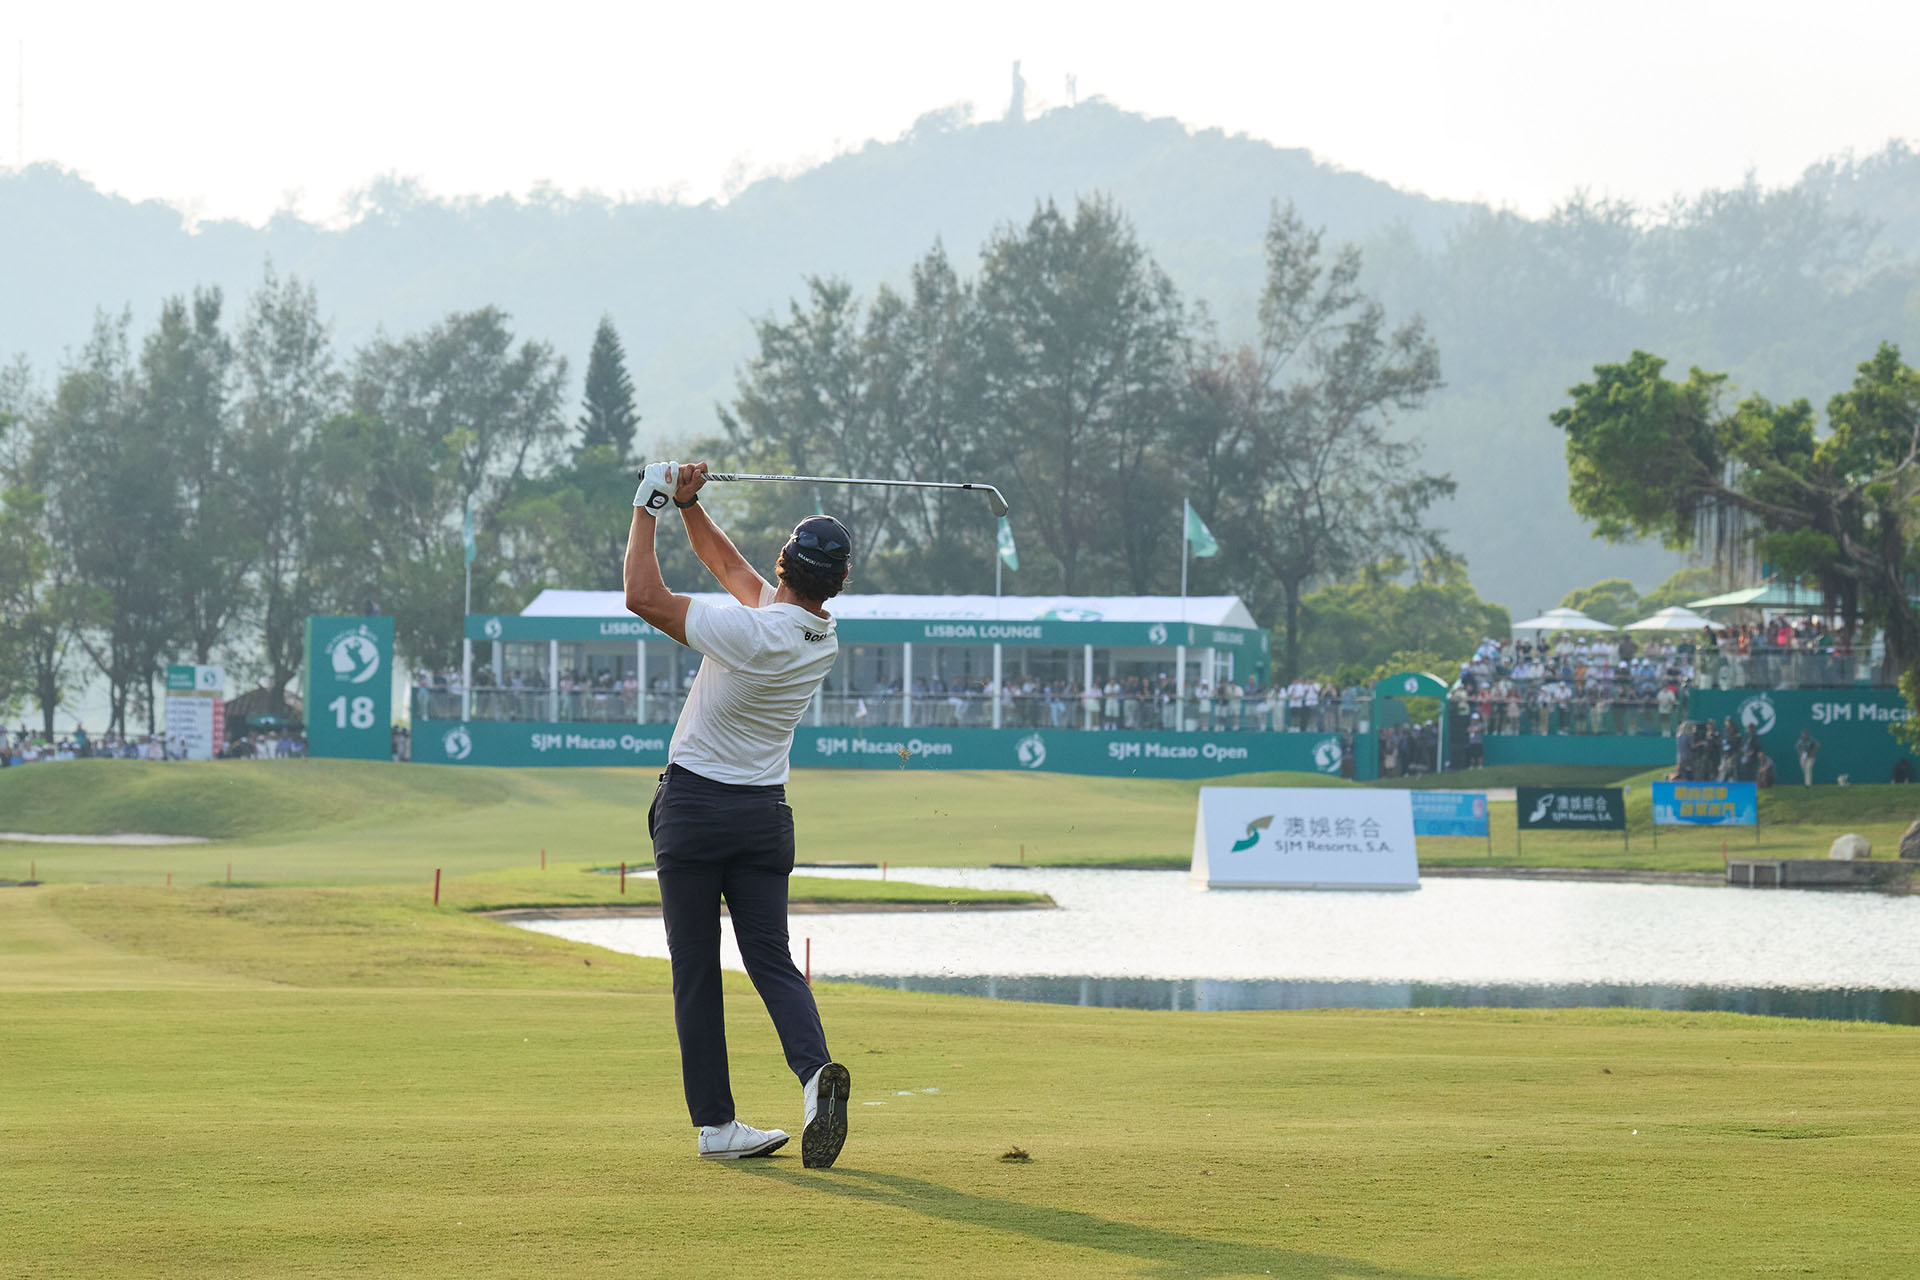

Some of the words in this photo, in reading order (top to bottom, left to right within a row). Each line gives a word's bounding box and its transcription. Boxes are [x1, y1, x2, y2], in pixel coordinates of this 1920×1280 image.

[600, 622, 651, 635] LISBOA
[924, 625, 978, 638] LISBOA
[980, 625, 1042, 639] LOUNGE
[328, 695, 375, 729] 18
[1811, 702, 1851, 725] SJM
[1858, 703, 1914, 721] Maca
[531, 733, 562, 752] SJM
[565, 734, 617, 750] Macao
[620, 734, 664, 753] Open
[816, 737, 848, 756] SJM
[907, 738, 952, 758] Open
[1108, 742, 1141, 760] SJM
[1144, 743, 1198, 758] Macao
[1202, 743, 1248, 762] Open
[1275, 840, 1302, 854] SJM
